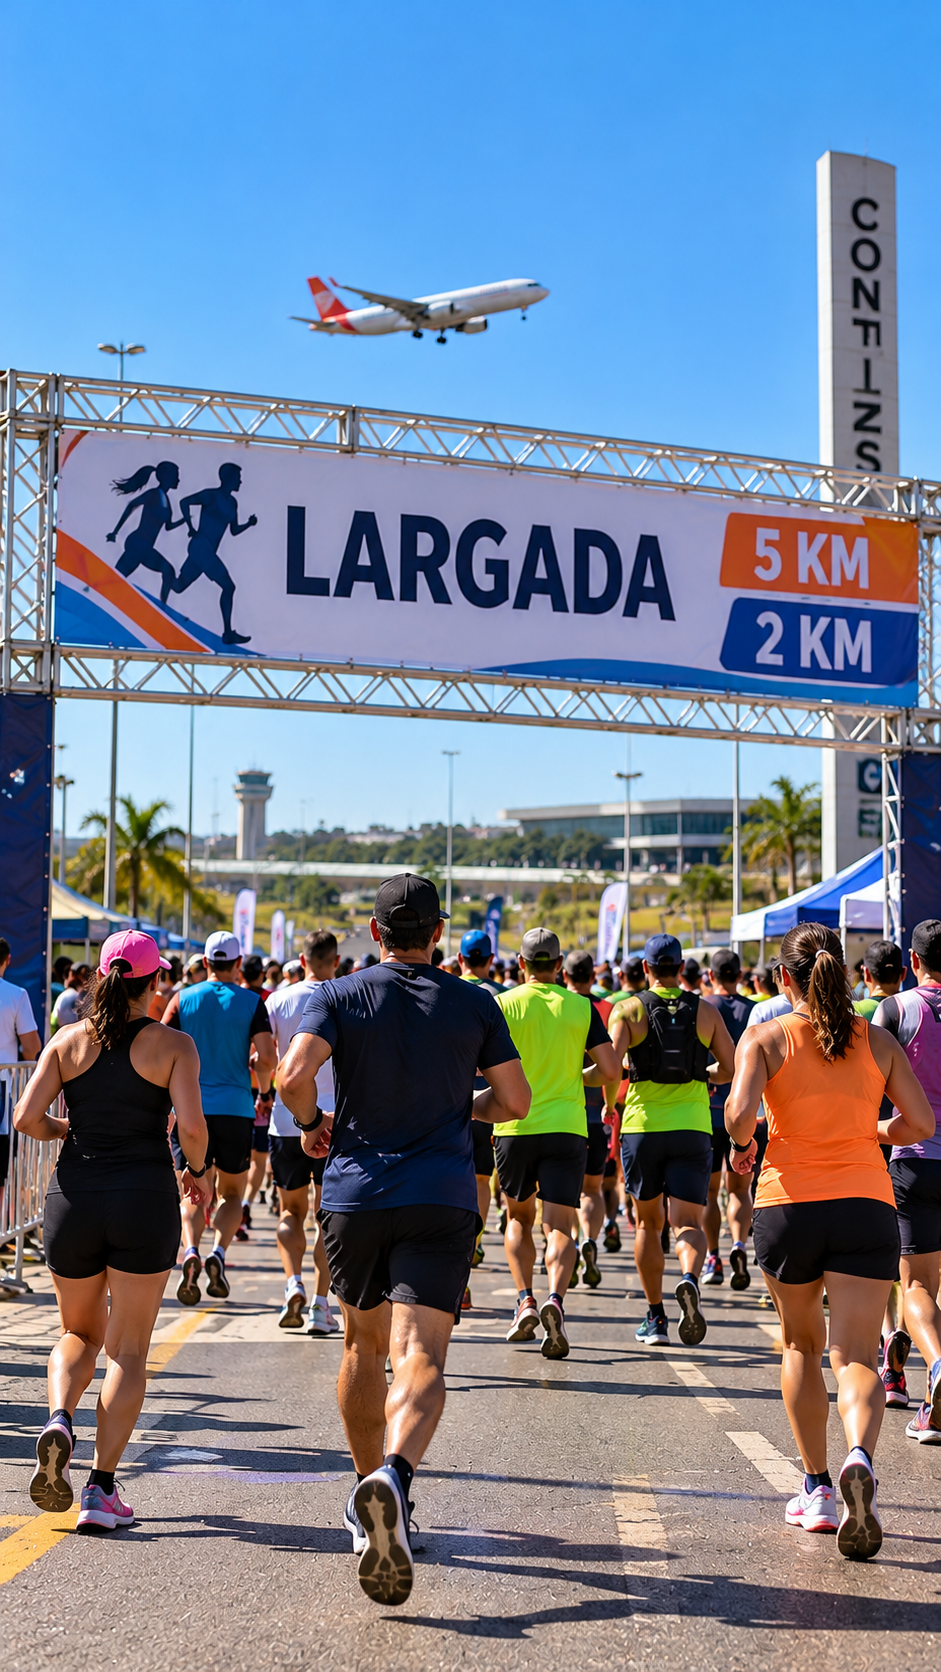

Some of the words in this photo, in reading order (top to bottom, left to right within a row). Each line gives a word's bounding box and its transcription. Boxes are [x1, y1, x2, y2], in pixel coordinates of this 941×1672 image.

[286, 505, 676, 621] LARGADA
[753, 527, 782, 581] 5
[797, 531, 869, 589] KM
[755, 611, 784, 666] 2
[799, 614, 872, 673] KM
